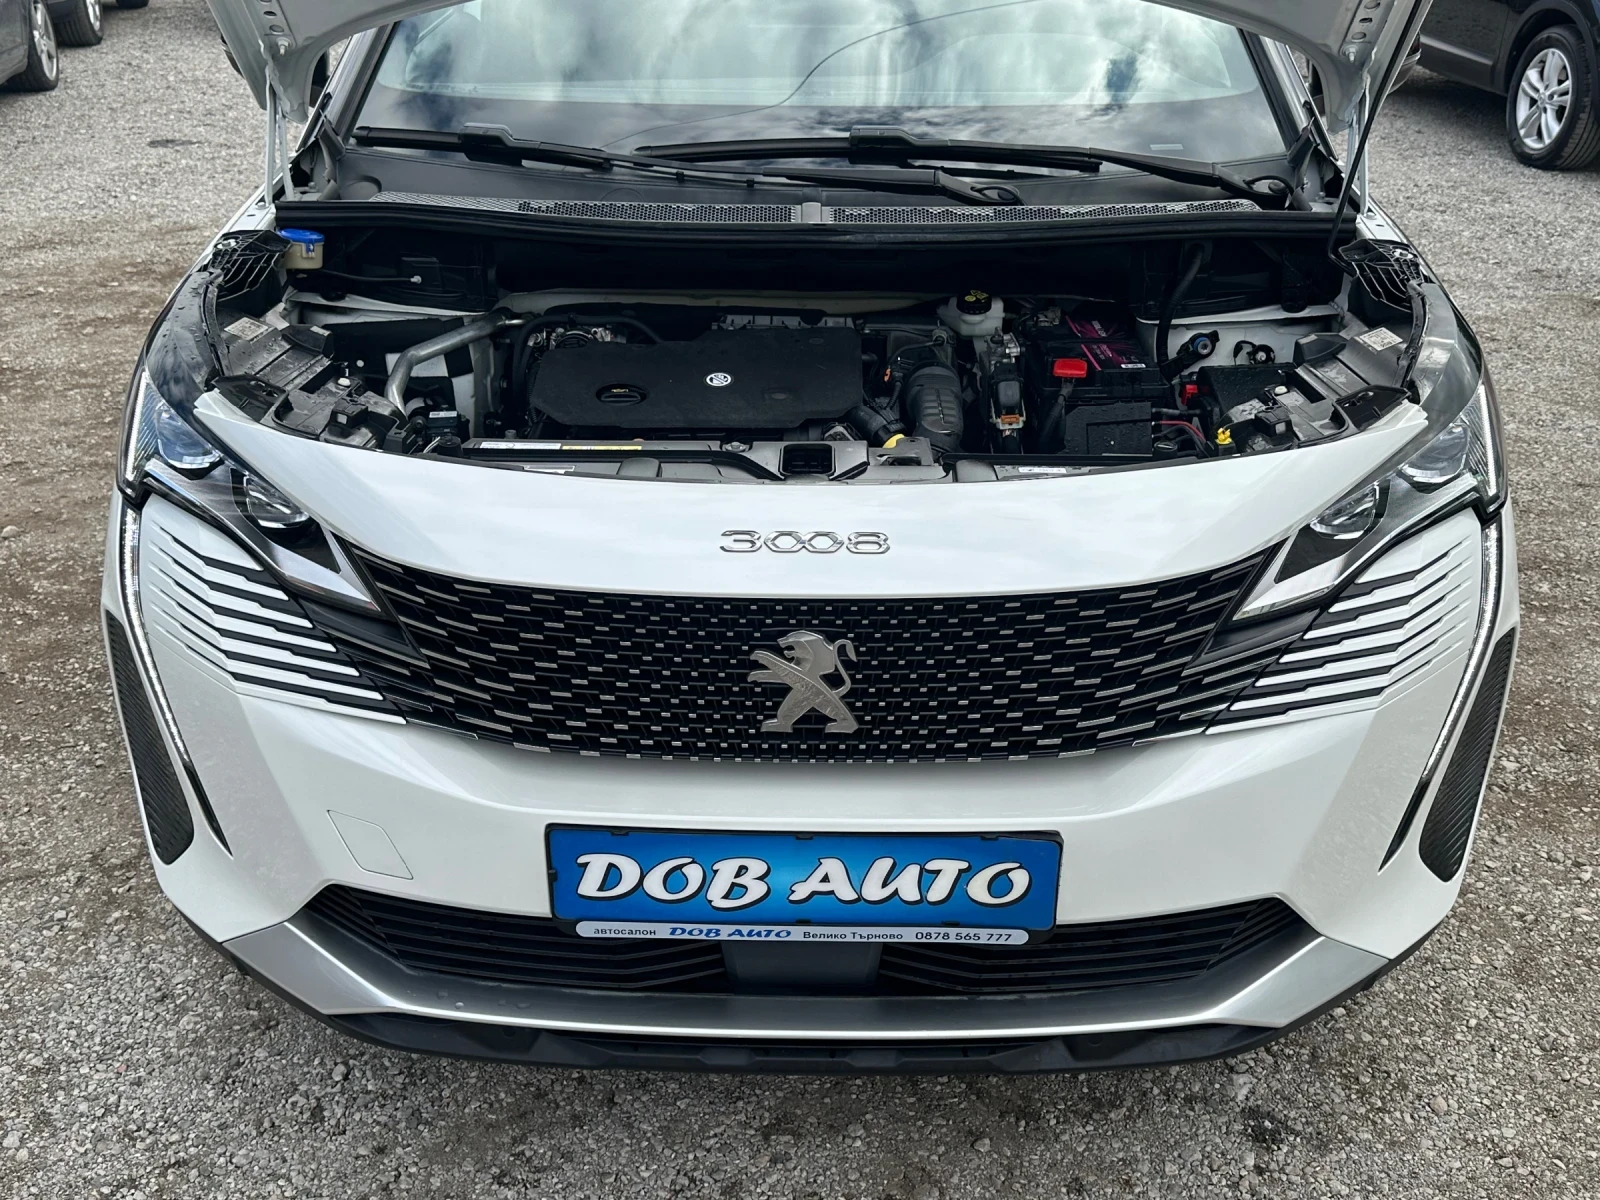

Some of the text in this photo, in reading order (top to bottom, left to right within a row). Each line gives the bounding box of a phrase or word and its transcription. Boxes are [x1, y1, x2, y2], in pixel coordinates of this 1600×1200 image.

[719, 529, 891, 555] 3008
[575, 852, 1032, 912] DOB AUTO
[593, 926, 1013, 942] автосалон DOB AUTO Велико Търново 0878 565 777
